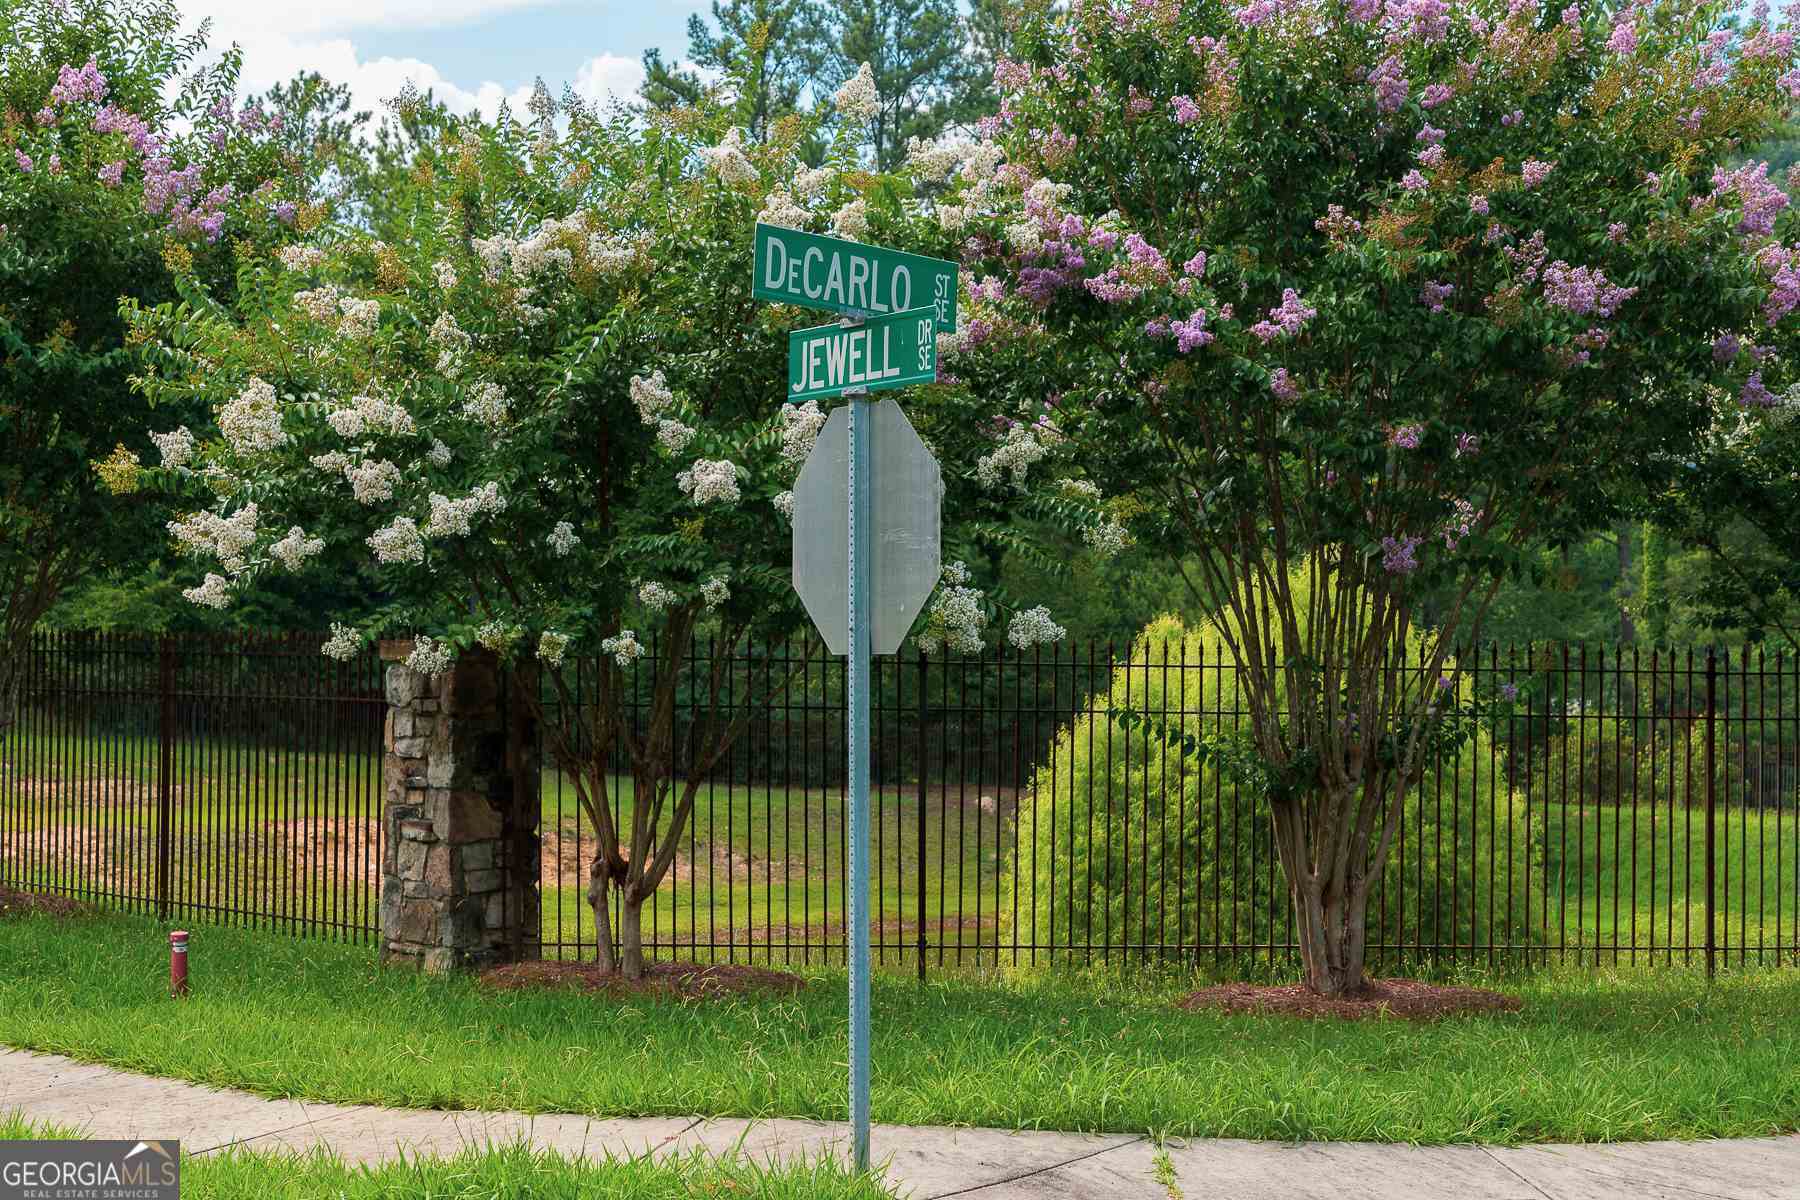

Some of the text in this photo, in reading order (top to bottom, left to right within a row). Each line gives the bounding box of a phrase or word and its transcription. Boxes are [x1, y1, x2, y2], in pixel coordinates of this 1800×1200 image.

[935, 273, 950, 299] ST
[934, 298, 950, 323] SE
[918, 318, 932, 345] DR
[792, 326, 900, 393] JEWELL
[918, 345, 931, 371] SE
